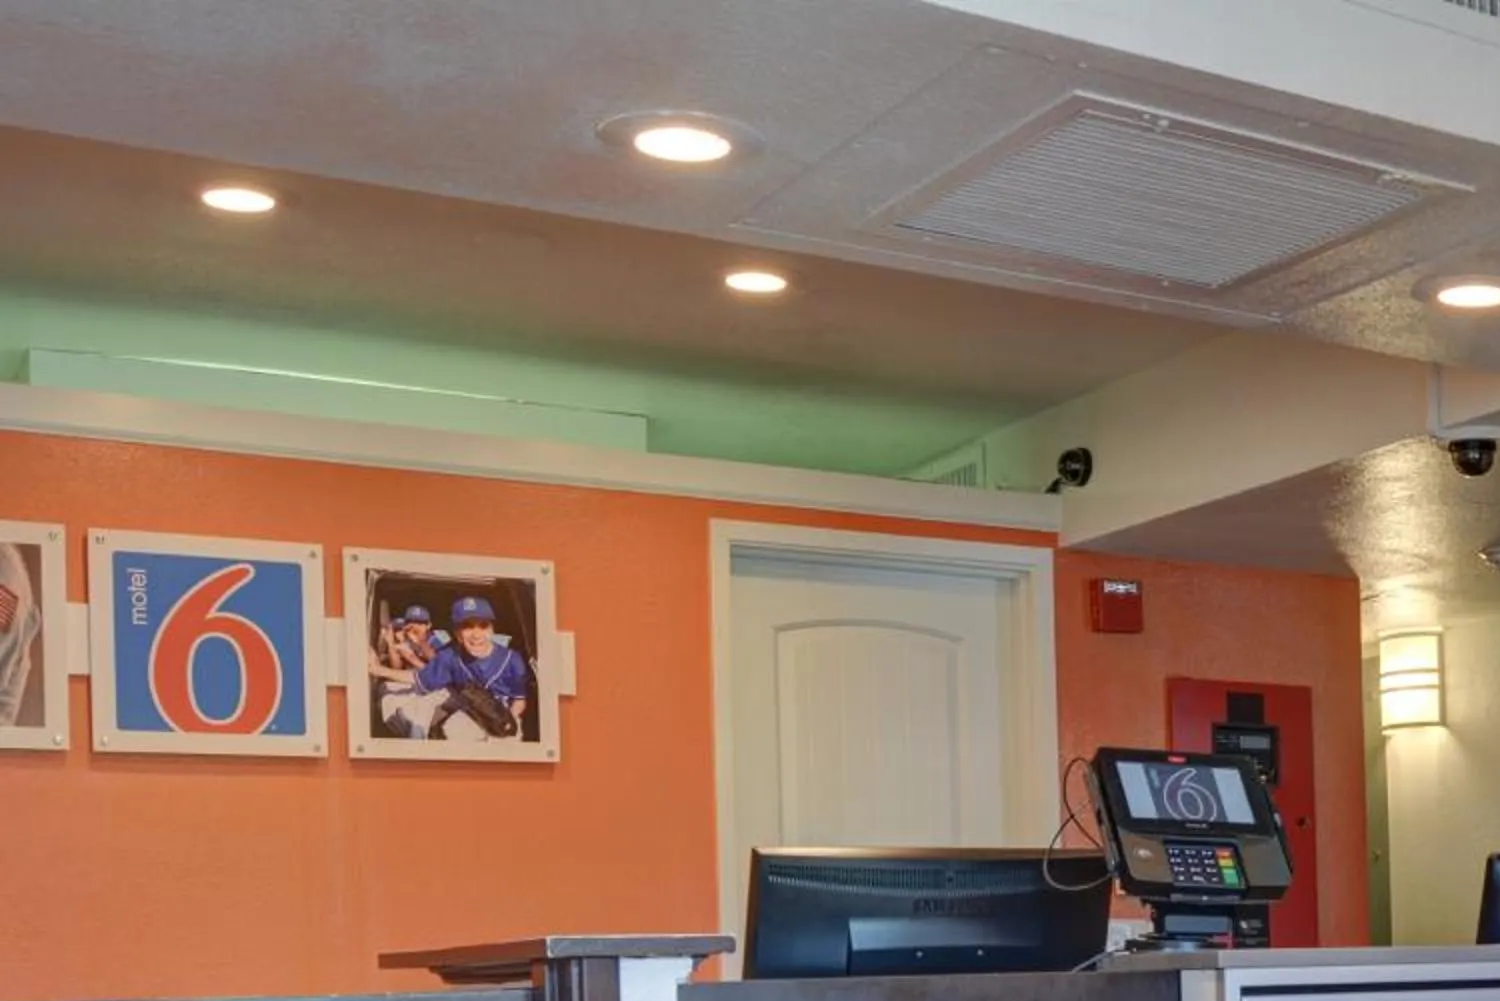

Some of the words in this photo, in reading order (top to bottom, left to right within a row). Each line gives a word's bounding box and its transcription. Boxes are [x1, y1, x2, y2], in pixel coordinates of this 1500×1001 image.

[127, 568, 148, 625] motel
[148, 563, 283, 735] 6
[1163, 767, 1218, 822] 6
